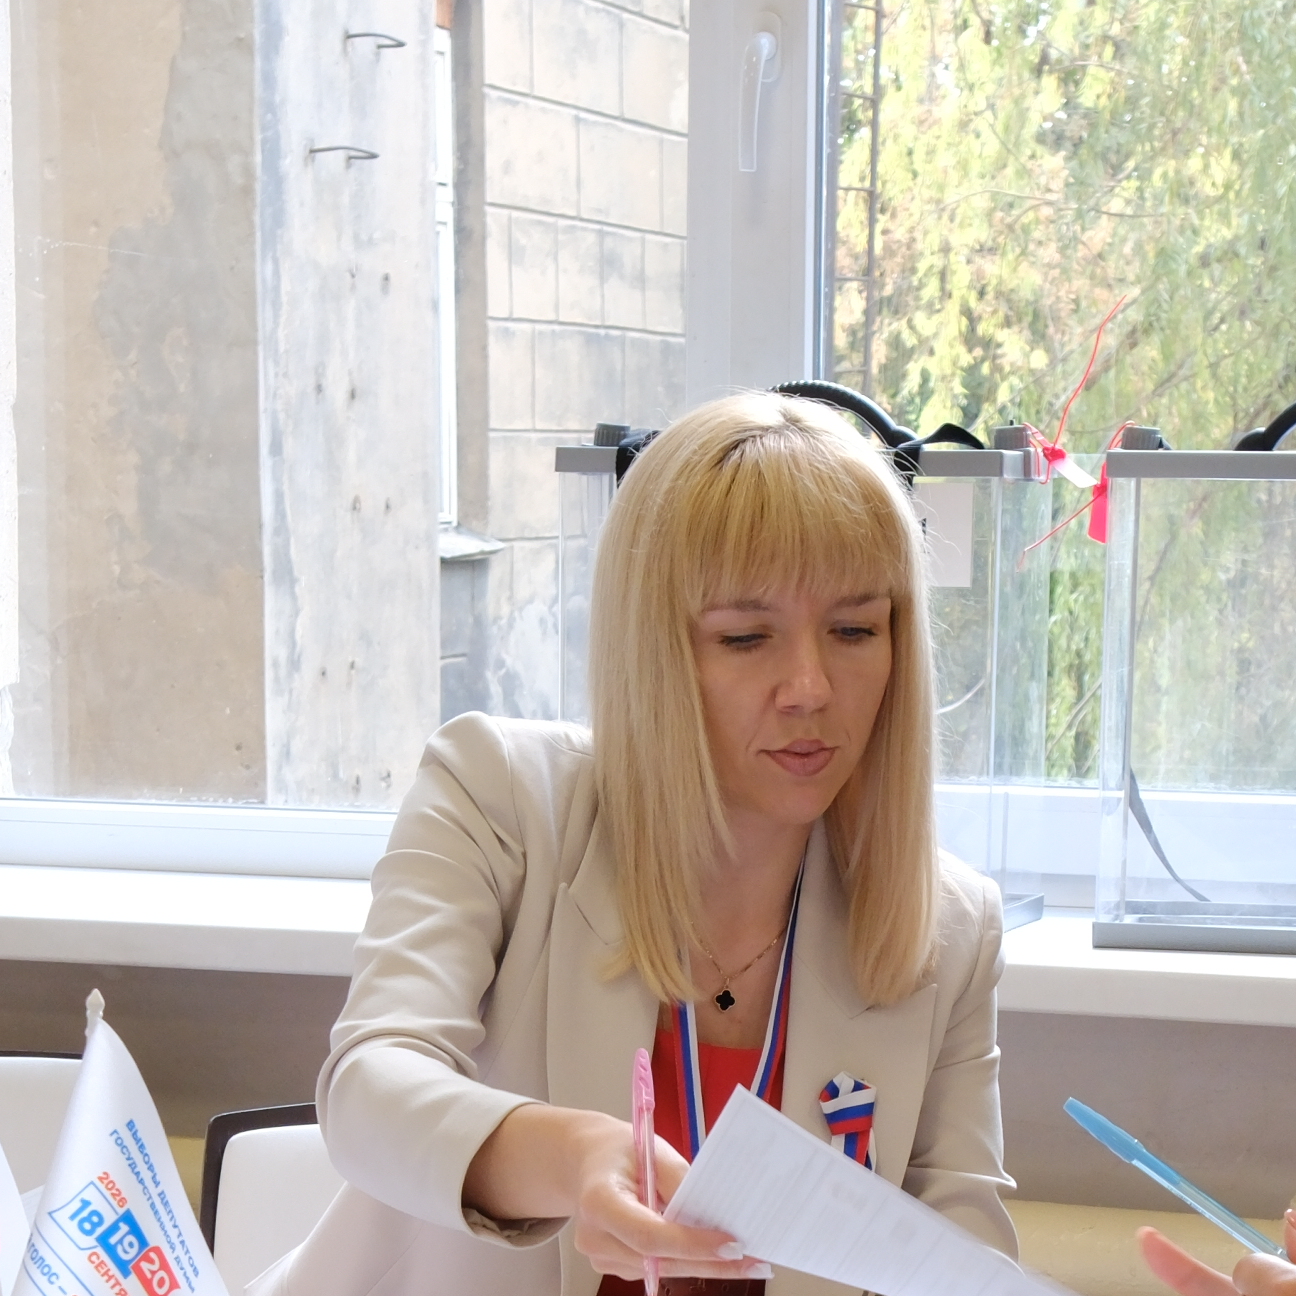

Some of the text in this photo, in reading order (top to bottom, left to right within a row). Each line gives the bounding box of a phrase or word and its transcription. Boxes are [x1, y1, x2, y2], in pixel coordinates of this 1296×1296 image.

[68, 1197, 171, 1296] 18 19 20
[97, 1171, 128, 1209] 2026
[109, 1128, 196, 1294] ГОСУДАРСТВЕННОЙ ДУМЫ
[125, 1118, 200, 1279] ВЫБОРЫ ДЕПУТАТОВ
